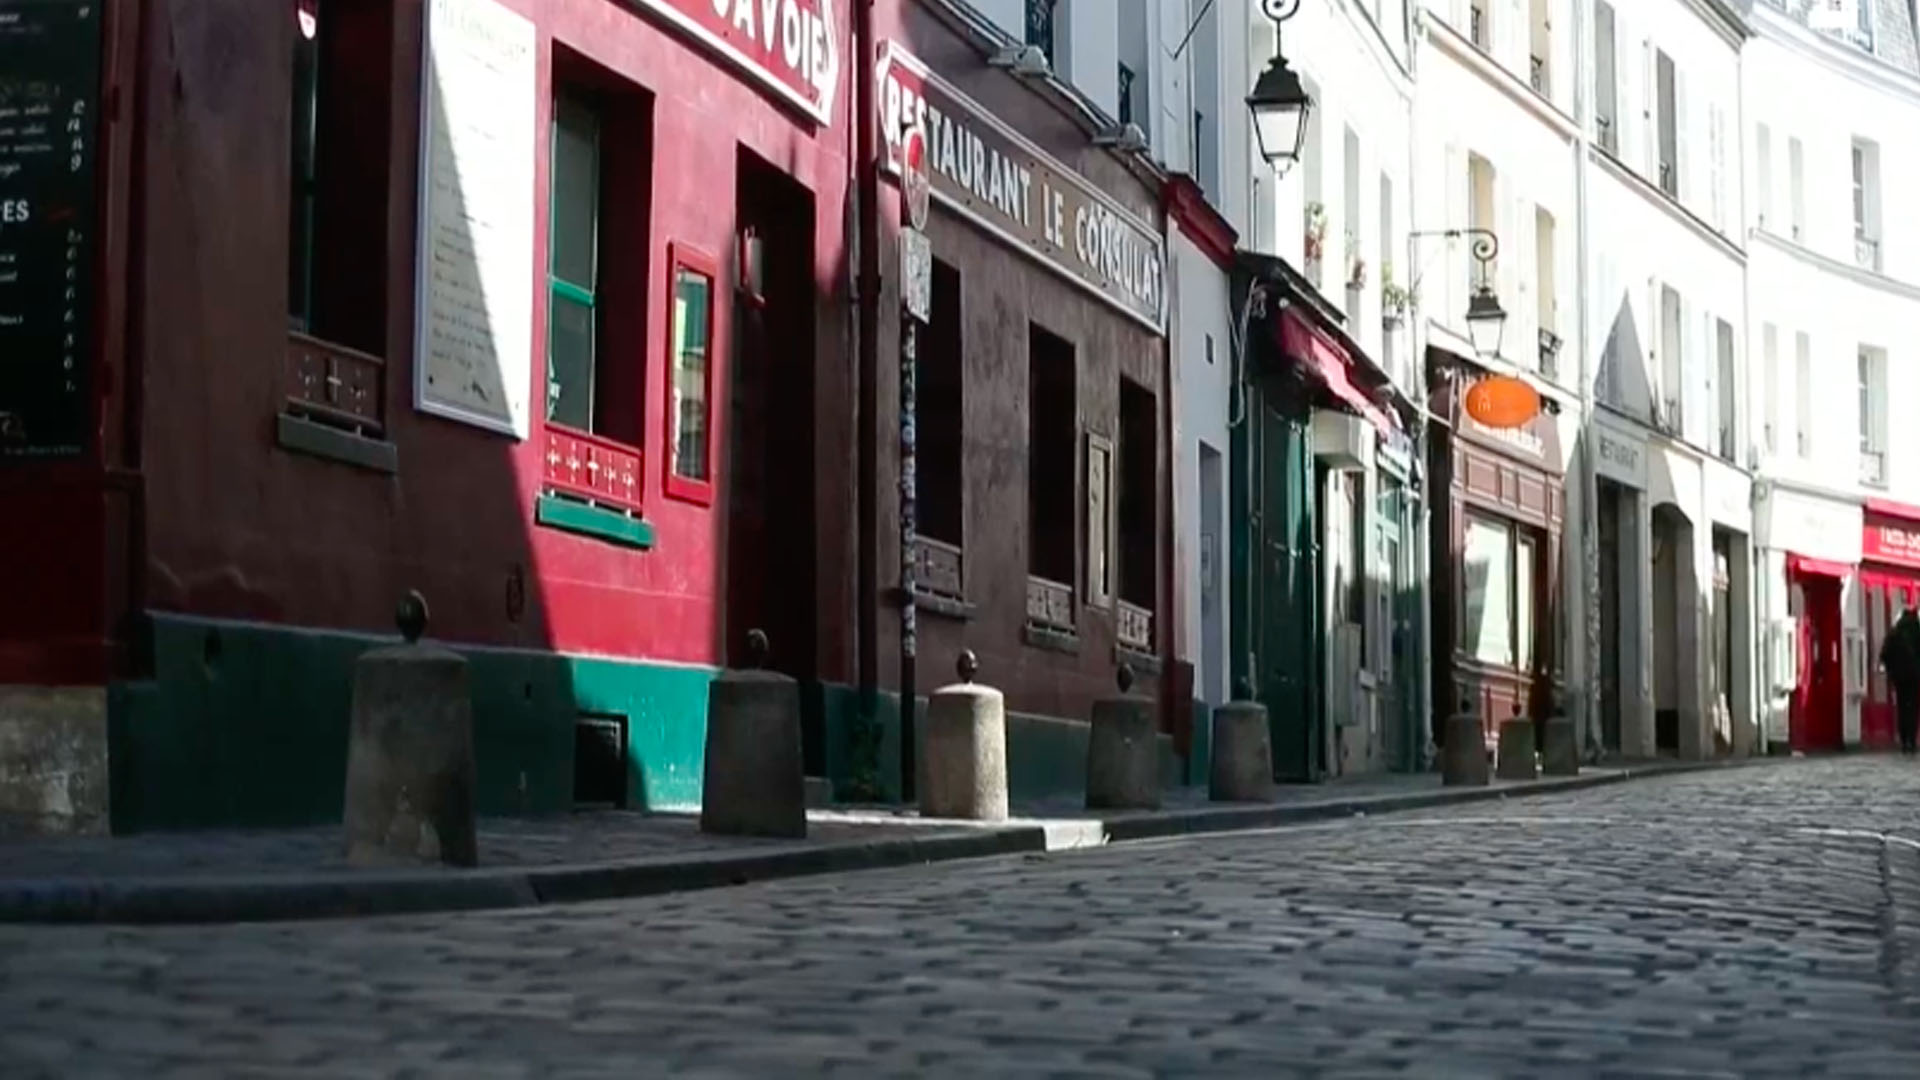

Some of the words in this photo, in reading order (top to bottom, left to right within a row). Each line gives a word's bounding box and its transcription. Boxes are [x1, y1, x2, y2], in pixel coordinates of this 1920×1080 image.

[712, 0, 829, 90] AVOIE
[0, 200, 30, 221] ES
[886, 73, 1030, 227] RESTAURANT
[1042, 183, 1064, 249] LE
[1076, 205, 1160, 307] CONSULAT
